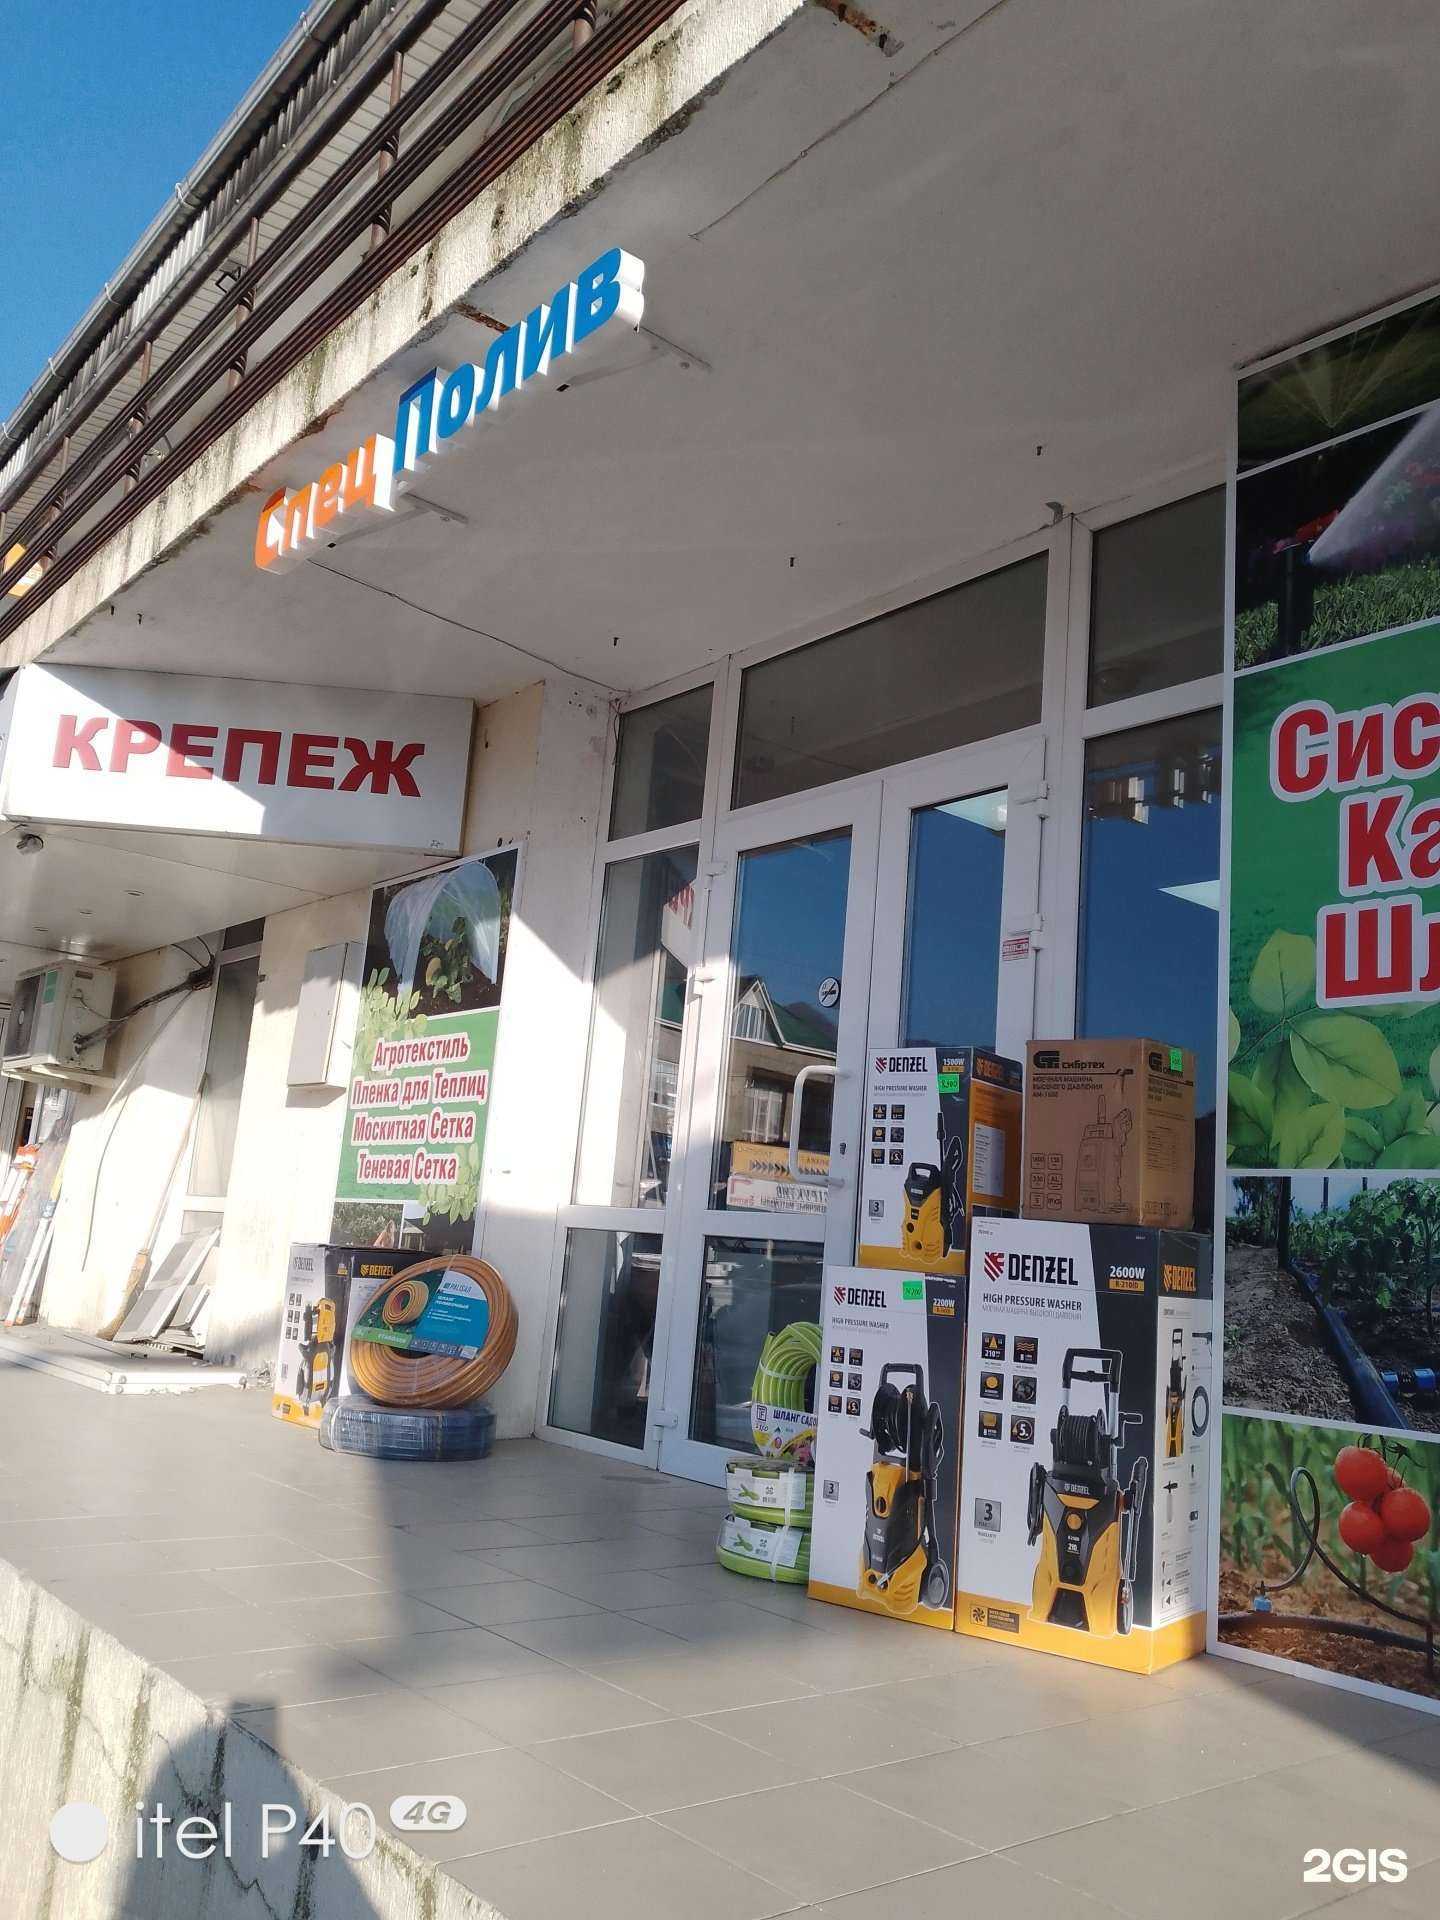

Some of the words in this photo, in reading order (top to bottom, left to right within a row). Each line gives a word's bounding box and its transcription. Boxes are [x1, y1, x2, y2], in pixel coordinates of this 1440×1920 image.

[52, 713, 426, 797] КРЕПЕЖ
[374, 1036, 468, 1070] Агротекстиль
[889, 1056, 928, 1073] DENZEL
[352, 1080, 399, 1105] Пленка
[402, 1080, 429, 1105] для
[435, 1072, 486, 1100] Теплиц
[353, 1116, 426, 1141] Москитная
[430, 1112, 474, 1139] Сетка
[359, 1153, 411, 1180] Теневая
[414, 1152, 457, 1180] Сетка
[369, 1265, 394, 1277] DENZEL
[1008, 1253, 1078, 1285] DENZEL
[1110, 1266, 1145, 1279] 2600W
[1172, 1266, 1196, 1292] DENZEL
[848, 1288, 887, 1308] DENZEL
[933, 1298, 955, 1307] 2200W
[983, 1293, 1003, 1304] HIGH
[1005, 1295, 1045, 1308] PRESSURE
[1047, 1299, 1082, 1311] WASHER
[844, 1318, 868, 1327] PRESSURE
[869, 1320, 889, 1329] WASHER
[801, 1415, 818, 1428] САДО
[829, 1483, 834, 1494] 3
[983, 1503, 993, 1521] 3
